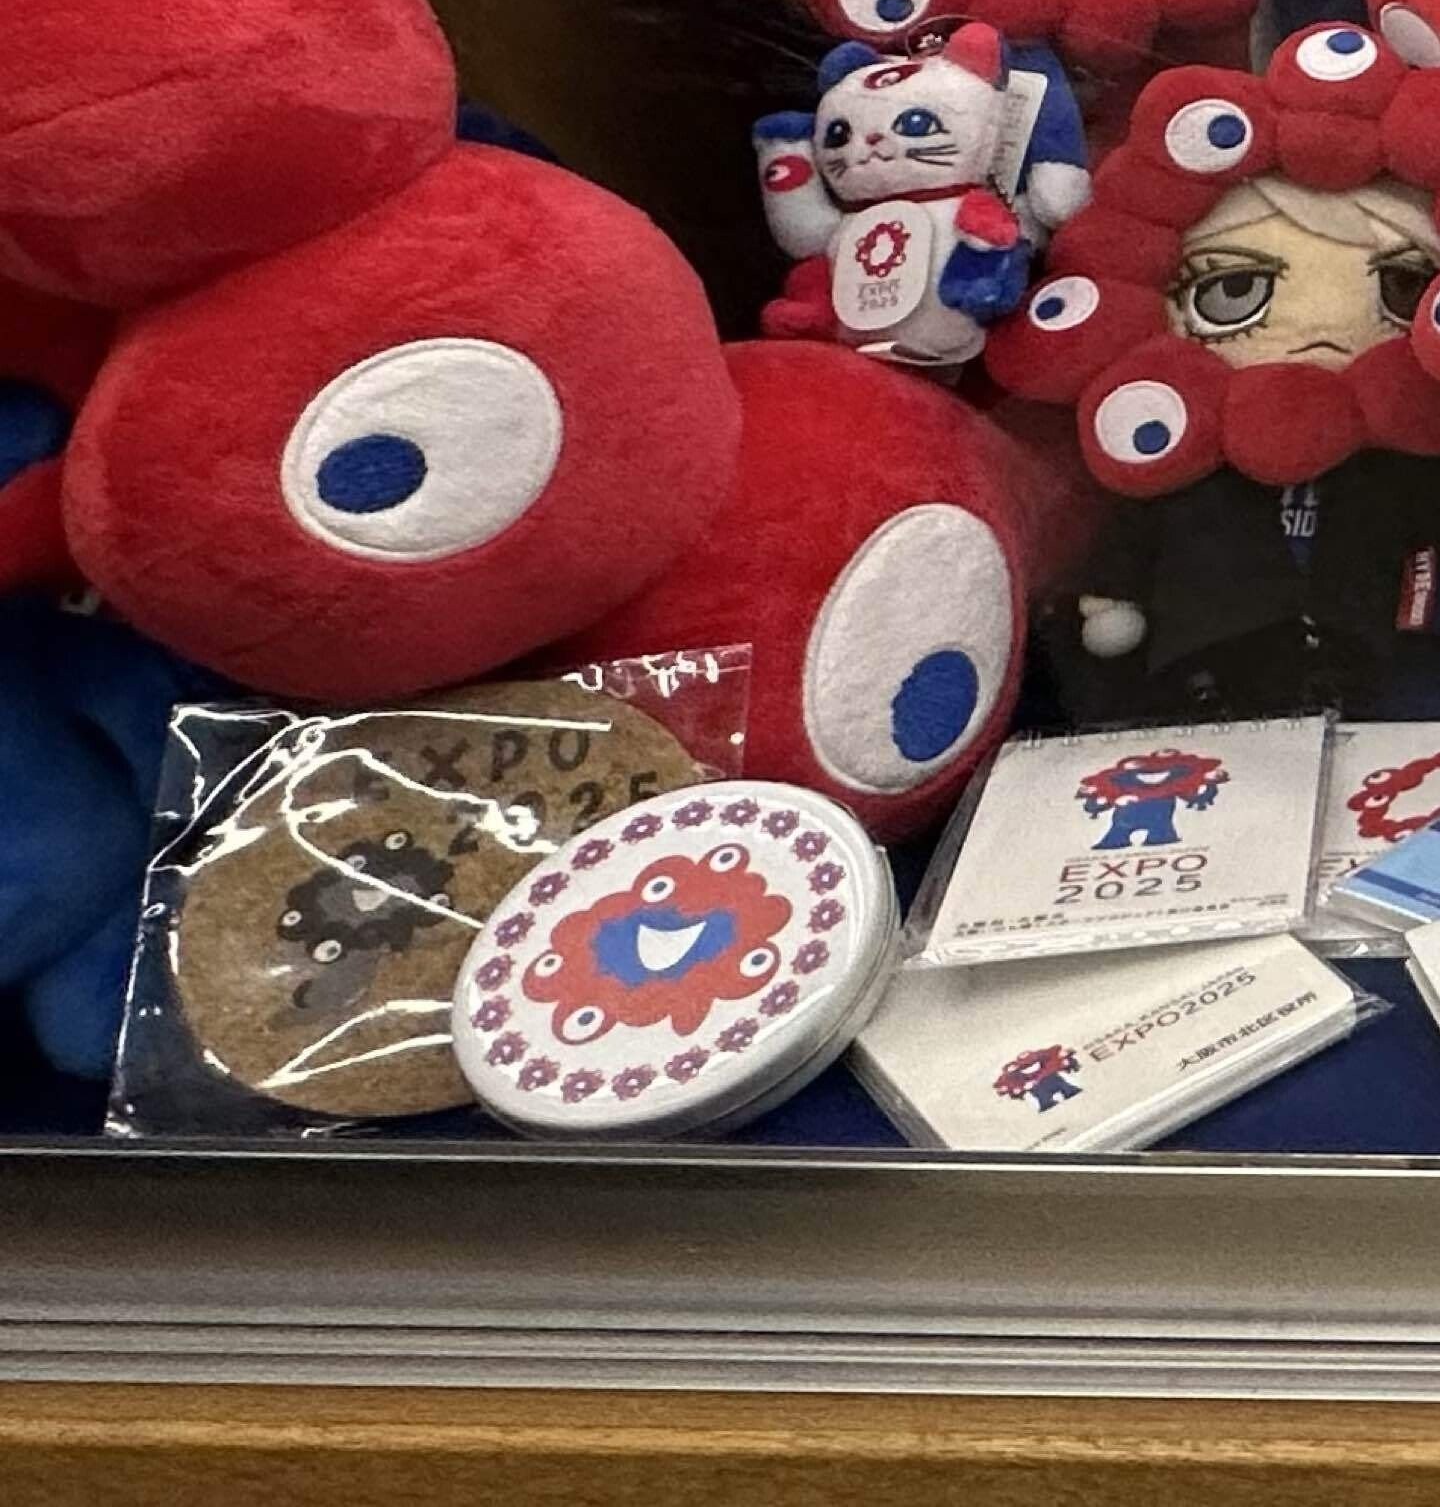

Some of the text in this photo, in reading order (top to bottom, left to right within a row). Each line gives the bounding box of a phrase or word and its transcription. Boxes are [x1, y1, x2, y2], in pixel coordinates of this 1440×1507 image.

[1059, 853, 1209, 884] EXPO
[1053, 873, 1203, 906] 2025
[1088, 970, 1258, 1063] EXPO2025
